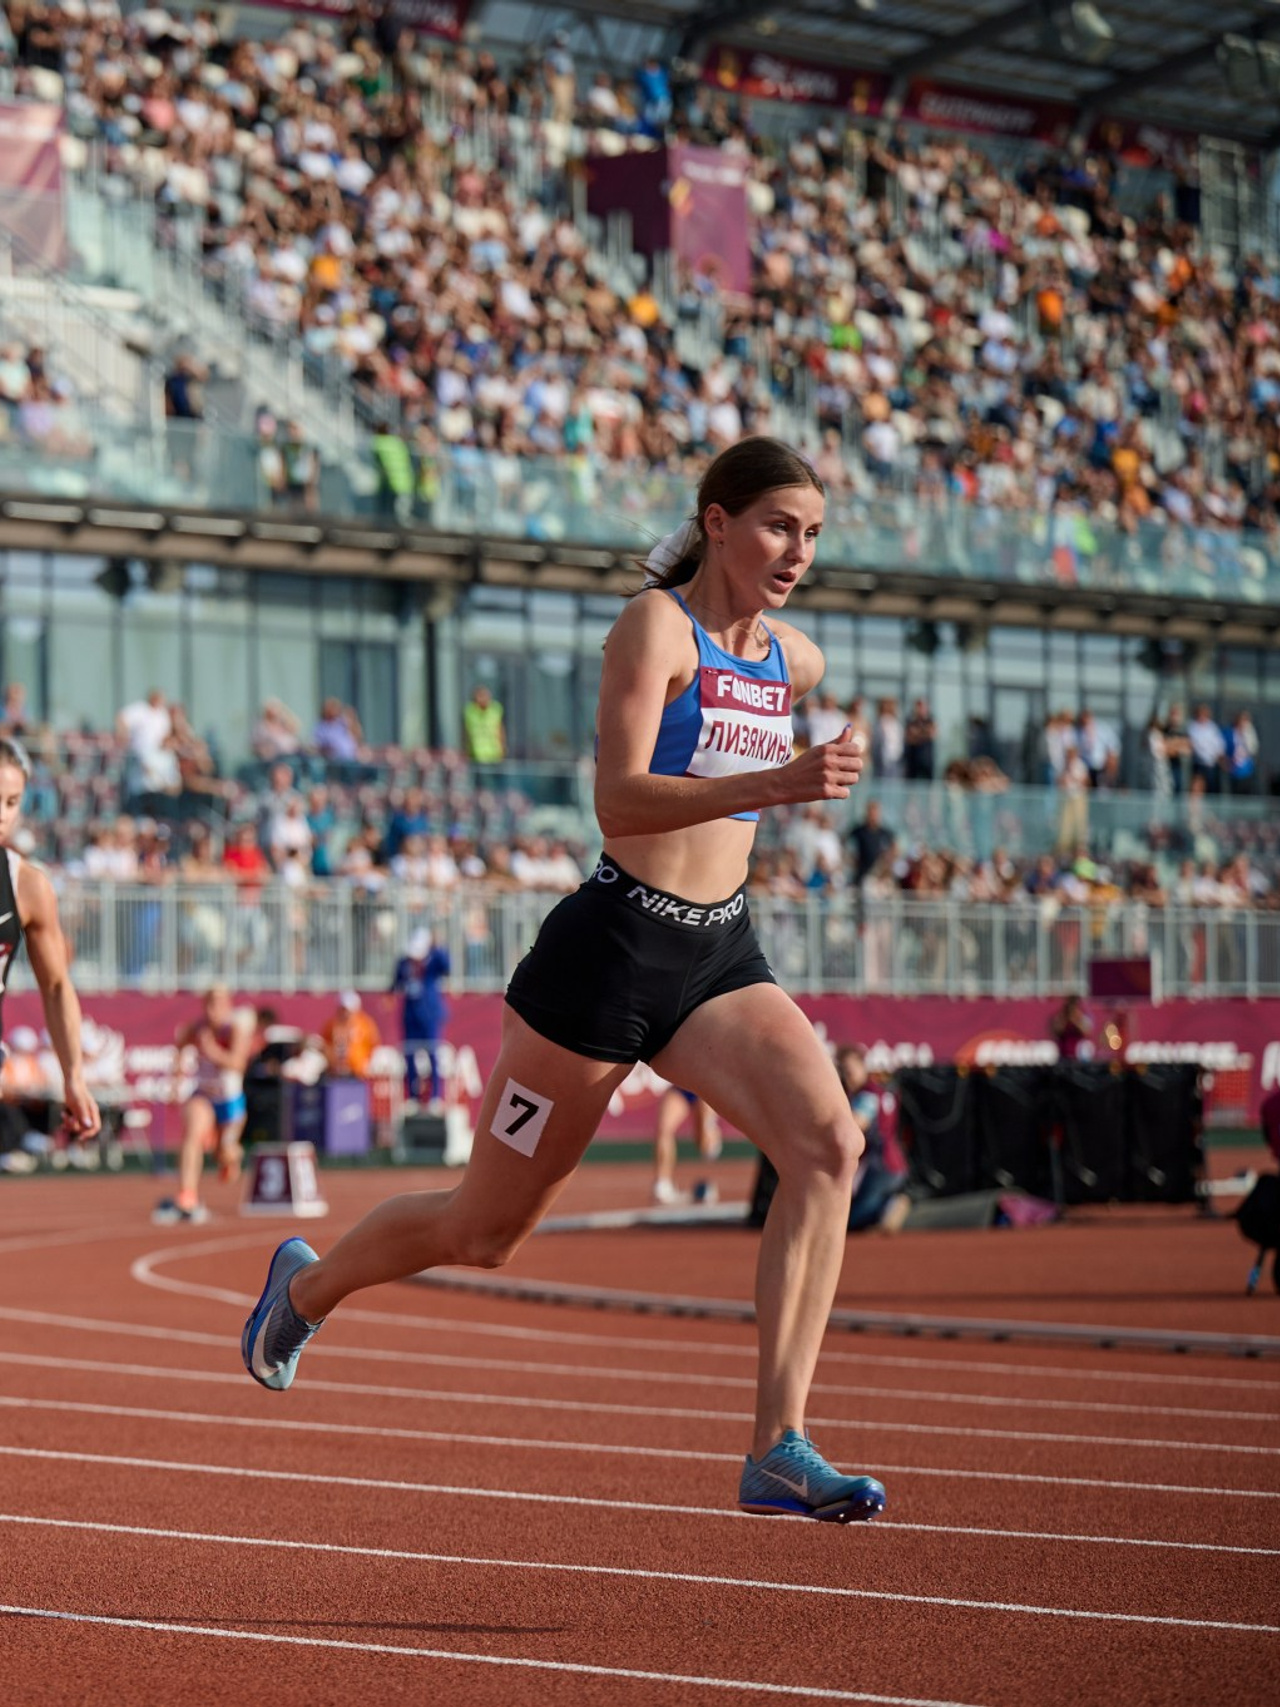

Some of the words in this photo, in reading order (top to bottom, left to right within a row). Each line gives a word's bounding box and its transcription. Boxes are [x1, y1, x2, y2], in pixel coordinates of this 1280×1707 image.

[717, 675, 786, 712] FONBET
[626, 885, 705, 926] NIKE
[704, 893, 744, 926] PRO
[505, 1093, 539, 1136] 7
[260, 1158, 286, 1201] 3
